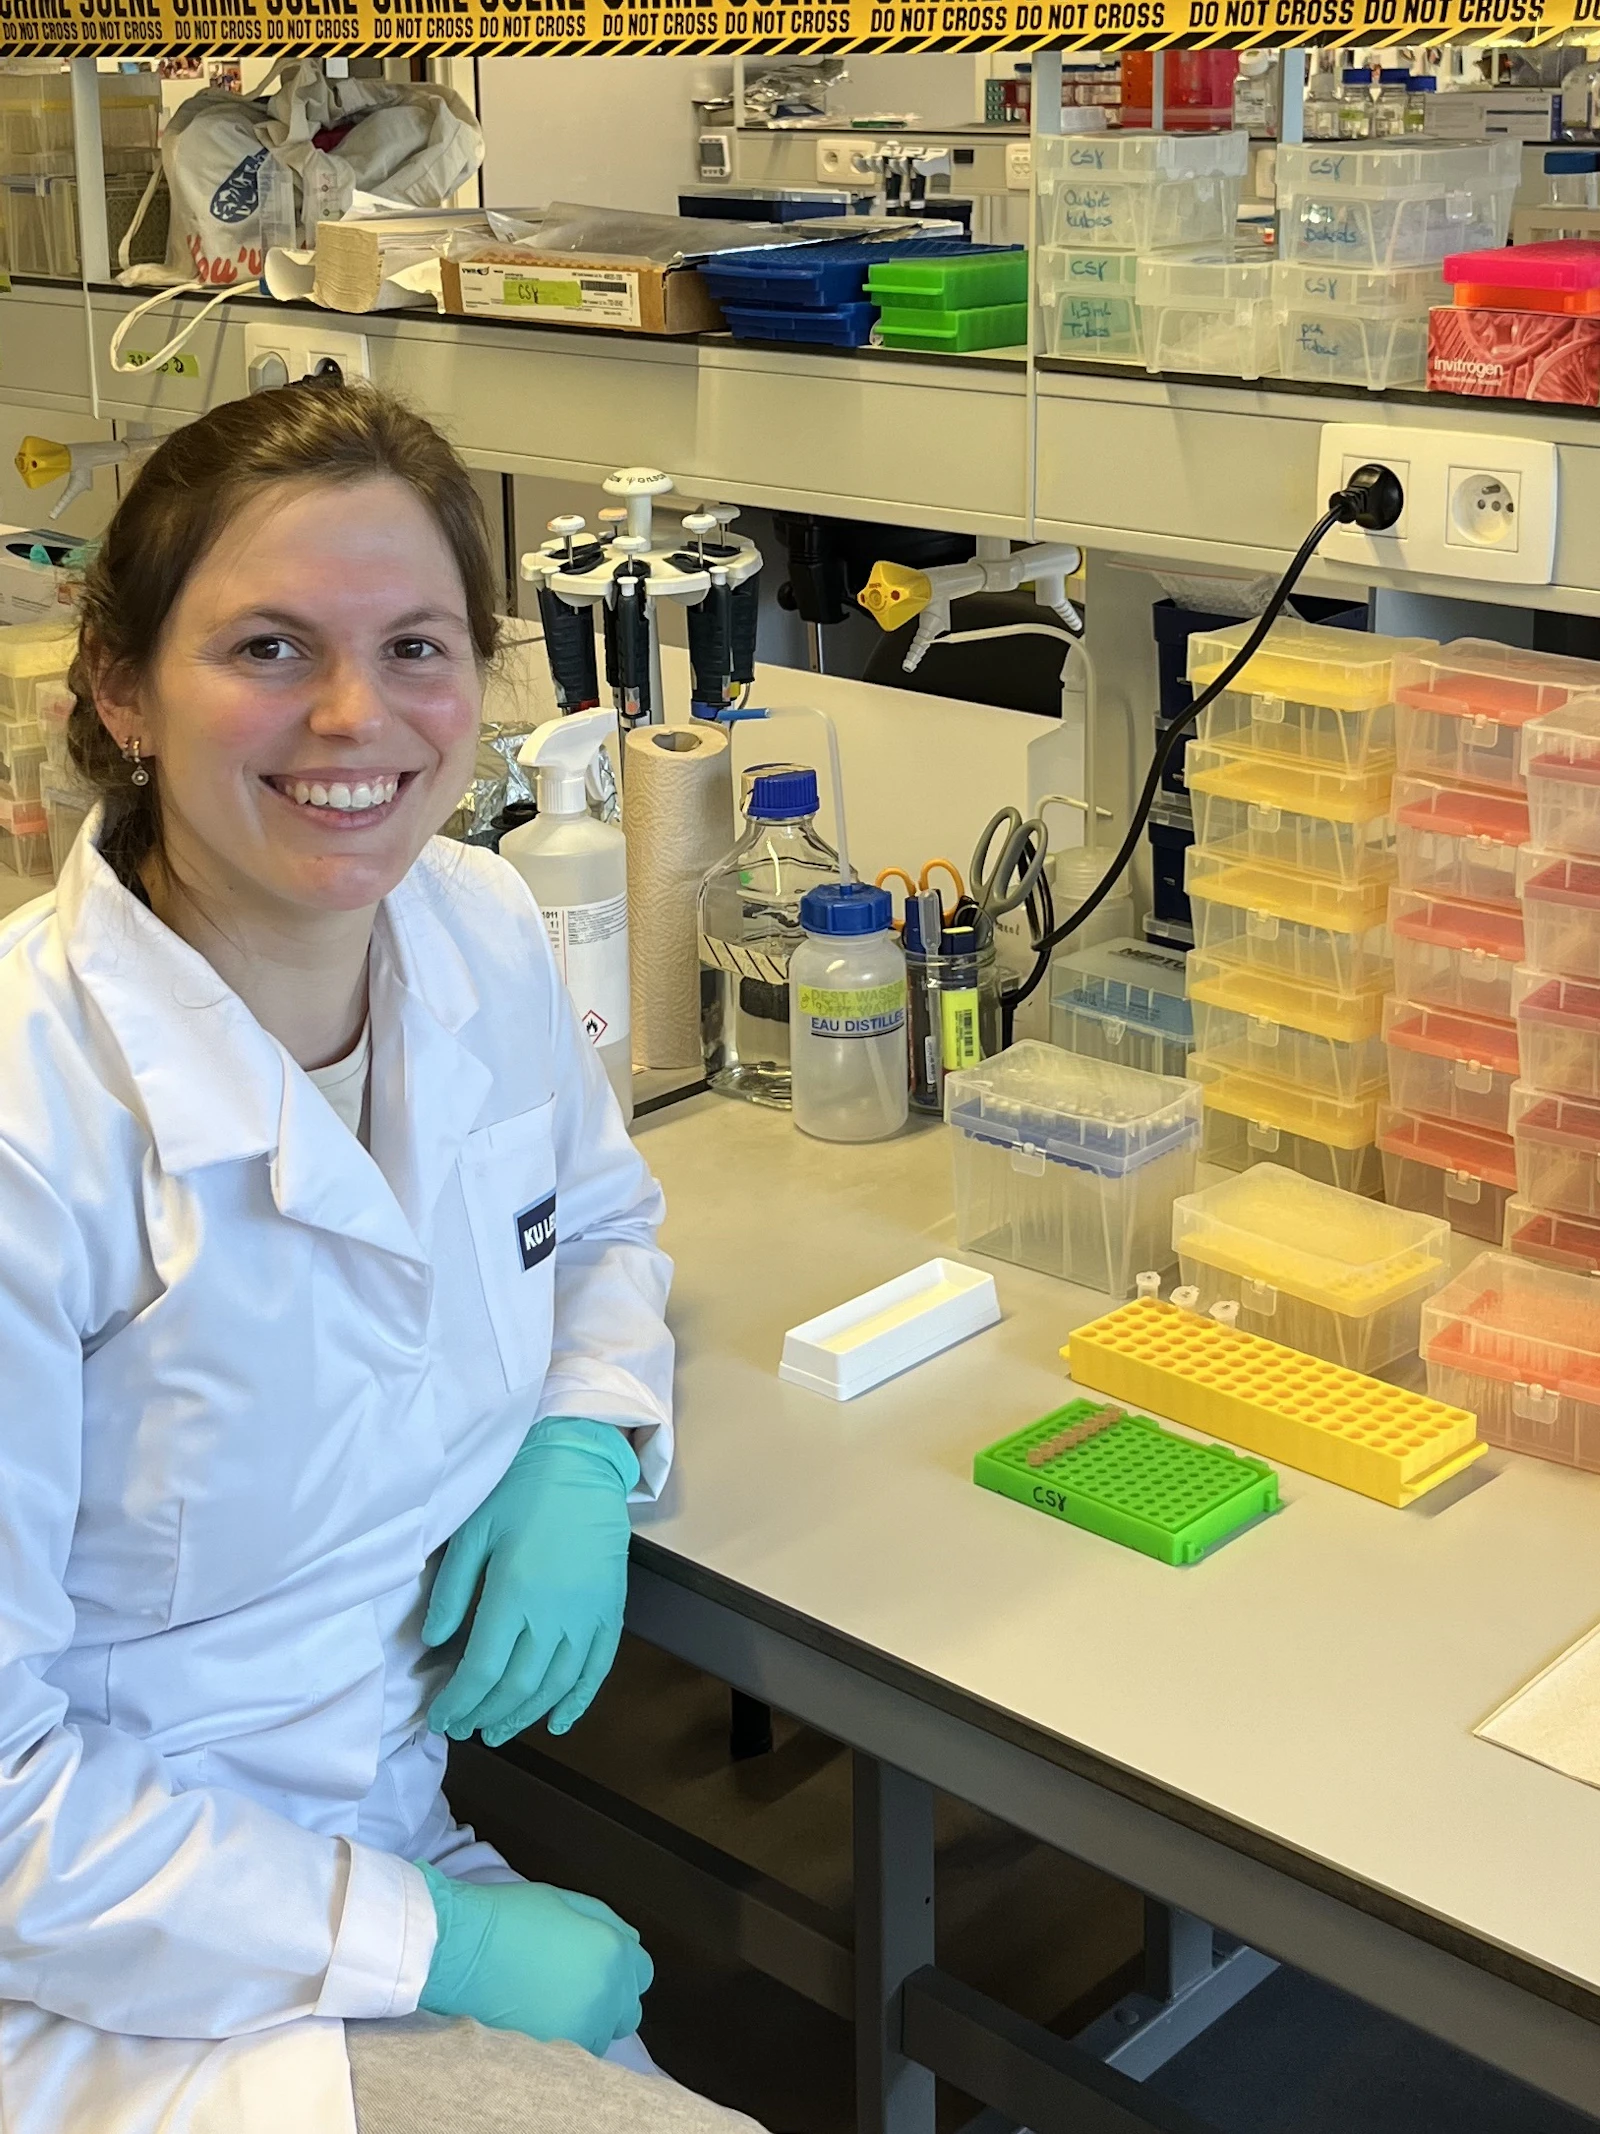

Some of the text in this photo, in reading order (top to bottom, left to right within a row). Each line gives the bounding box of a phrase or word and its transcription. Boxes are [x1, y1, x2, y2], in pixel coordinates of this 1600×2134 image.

[3, 21, 17, 40] DO
[19, 22, 38, 40] NOT
[42, 22, 78, 40] CROSS
[82, 22, 97, 40] DO
[100, 21, 120, 40] NOT
[124, 21, 163, 40] CROSS
[175, 20, 191, 40] DO
[195, 20, 217, 39] NOT
[221, 20, 262, 39] CROSS
[267, 20, 284, 39] DO
[287, 19, 311, 39] NOT
[315, 19, 359, 39] CROSS
[374, 18, 392, 39] DO
[396, 18, 423, 38] NOT
[426, 17, 473, 38] CROSS
[479, 17, 499, 38] DO
[502, 16, 531, 38] NOT
[535, 15, 586, 37] CROSS
[603, 14, 624, 37] DO
[628, 14, 659, 36] NOT
[663, 12, 718, 36] CROSS
[725, 12, 748, 35] DO
[752, 11, 786, 34] NOT
[791, 10, 850, 34] CROSS
[870, 9, 895, 33] DO
[900, 8, 938, 32] NOT
[942, 5, 1008, 31] CROSS
[1015, 5, 1043, 30] DO
[1048, 4, 1089, 30] NOT
[1094, 3, 1165, 29] CROSS
[1189, 2, 1219, 27] DO
[1224, 0, 1270, 27] NOT
[1275, 0, 1354, 26] CROSS
[1363, 0, 1397, 24] DO
[1402, 0, 1450, 24] NOT
[1457, 0, 1545, 23] CROSS
[1066, 210, 1113, 228] tubes
[1063, 321, 1111, 338] Tubes
[1434, 356, 1504, 378] invitrogen
[811, 1017, 839, 1031] EAU
[524, 1222, 544, 1251] KU
